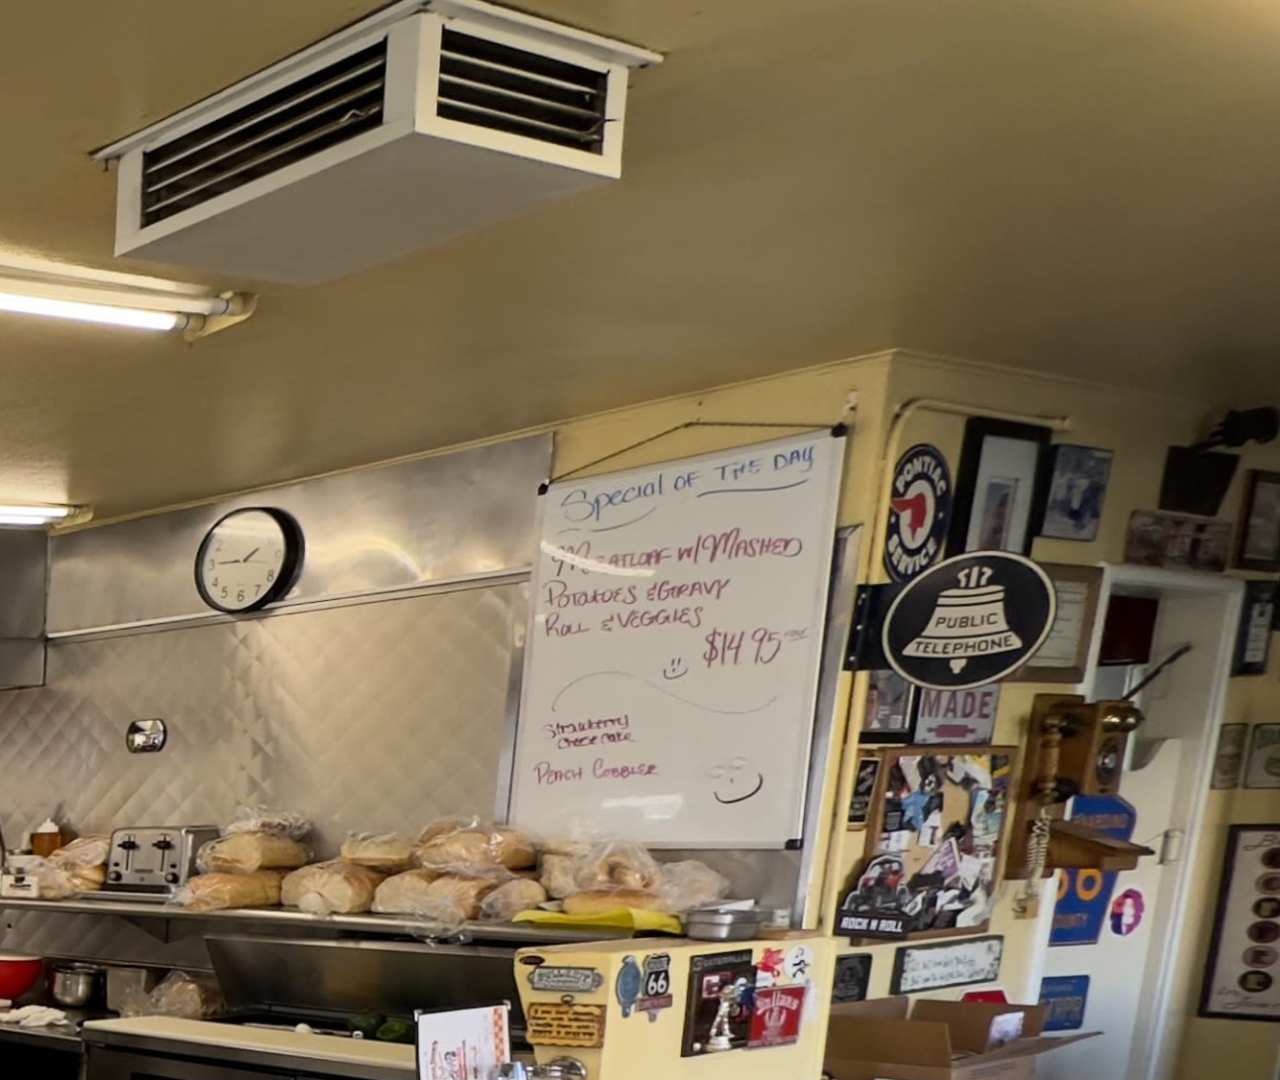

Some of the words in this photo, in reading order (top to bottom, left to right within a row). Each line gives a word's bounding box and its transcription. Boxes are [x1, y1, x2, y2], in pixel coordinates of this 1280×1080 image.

[895, 455, 947, 496] PONTIAC
[560, 473, 664, 523] Special
[887, 532, 939, 576] SERVICE
[220, 585, 229, 599] 5
[236, 589, 245, 603] 6
[934, 611, 999, 629] PUBLIC
[914, 633, 1014, 655] TELEPHONE
[920, 691, 994, 720] MADE
[840, 916, 870, 930] ROCK
[878, 918, 904, 933] ROLL
[647, 972, 668, 995] 66
